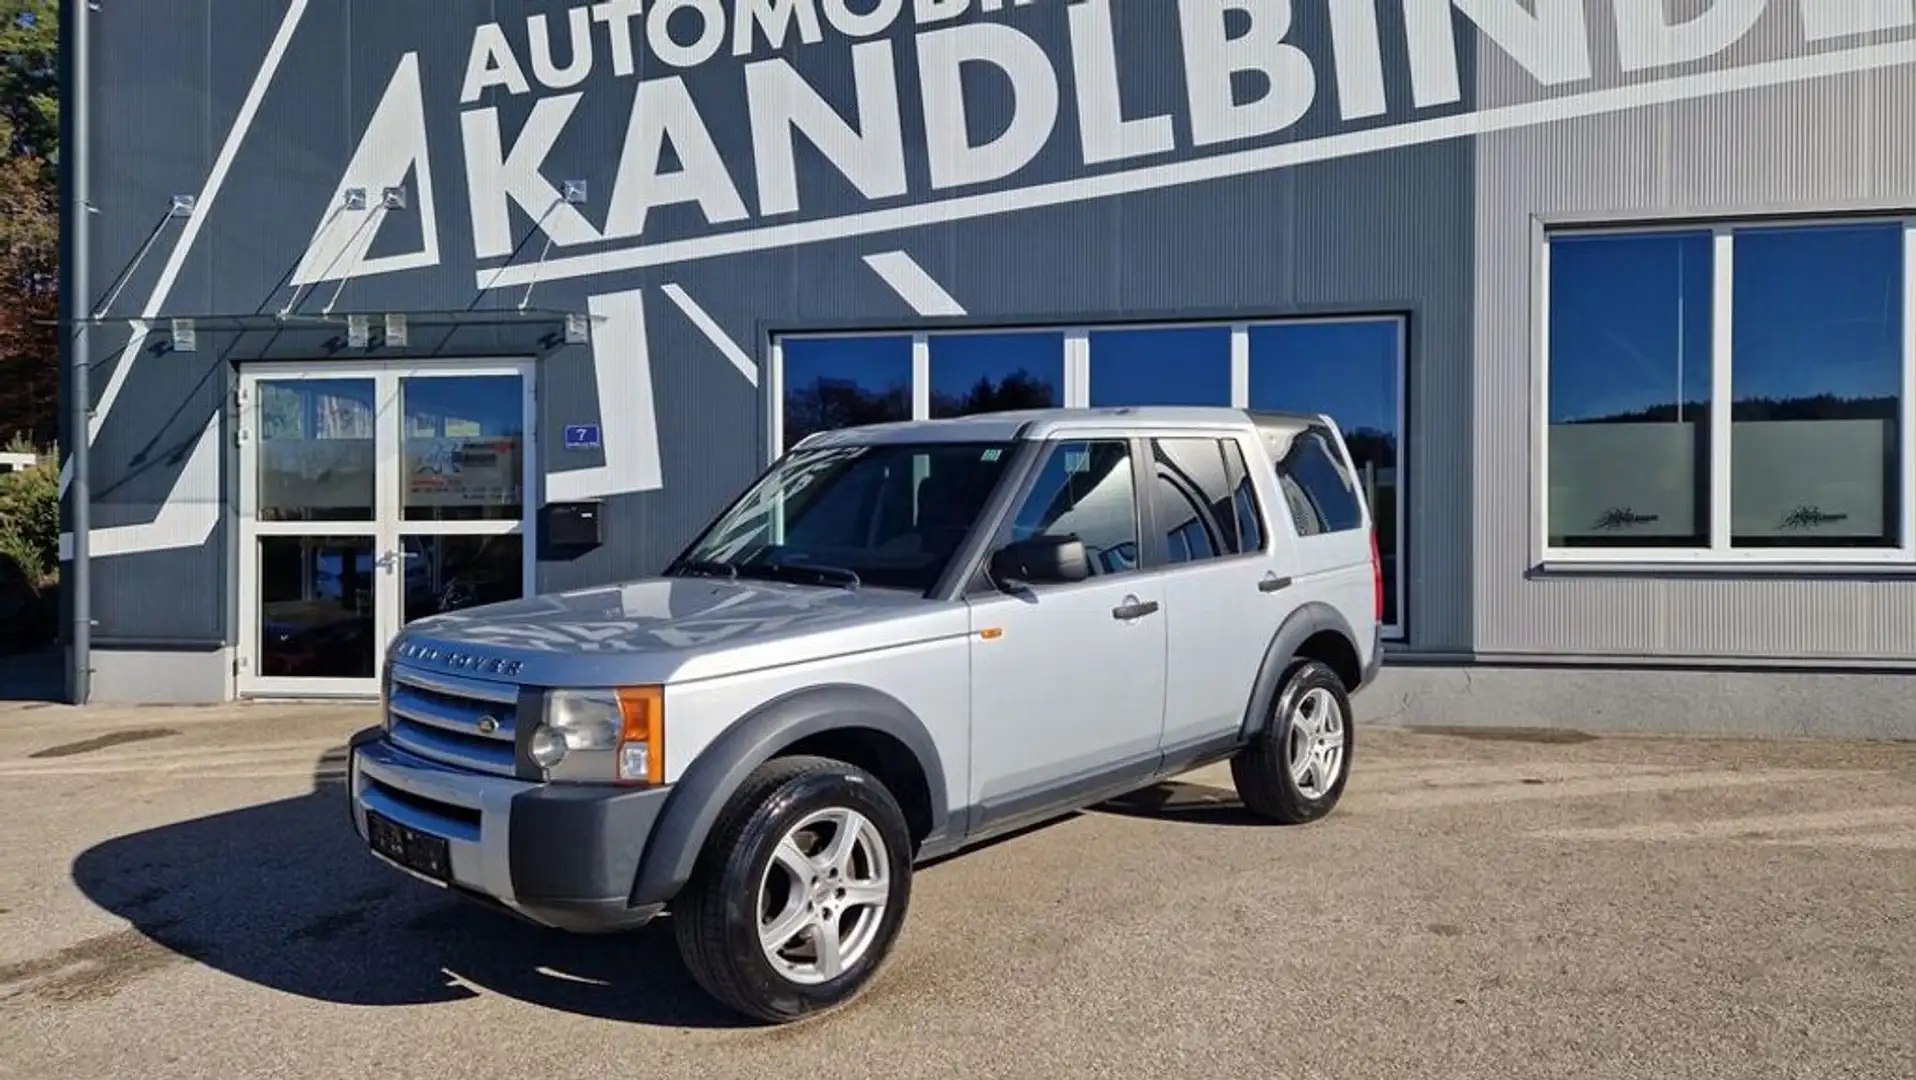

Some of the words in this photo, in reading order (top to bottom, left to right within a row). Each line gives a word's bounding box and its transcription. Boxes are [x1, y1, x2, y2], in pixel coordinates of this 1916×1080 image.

[459, 0, 1030, 102] AUTOMO
[460, 0, 1914, 260] KANDLBIN
[575, 428, 588, 441] 7
